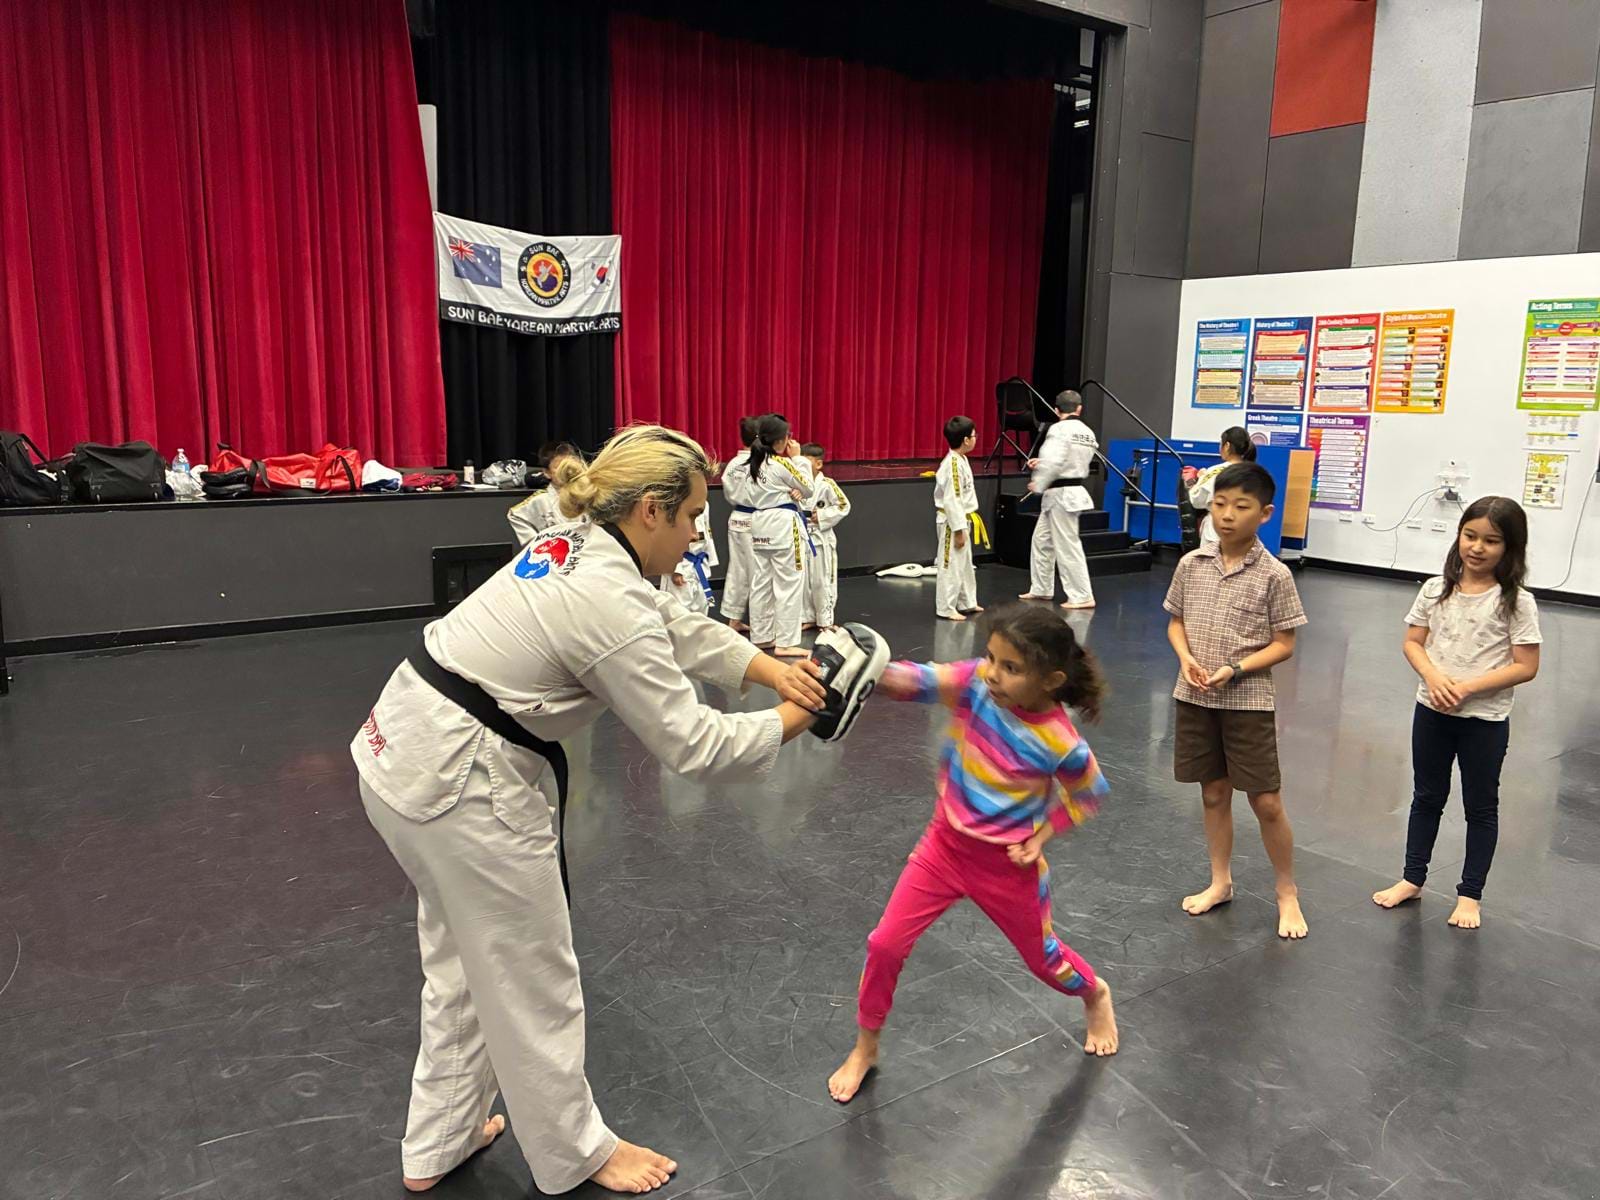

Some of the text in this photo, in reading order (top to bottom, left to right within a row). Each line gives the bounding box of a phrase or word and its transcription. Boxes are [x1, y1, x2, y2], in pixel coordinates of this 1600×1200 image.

[528, 244, 544, 255] SUN
[1530, 303, 1553, 312] Acting
[447, 305, 475, 321] SUN
[478, 310, 504, 326] BAE
[554, 320, 599, 334] MARTIAL
[599, 316, 620, 329] ARTS
[1309, 416, 1337, 425] Theatrical
